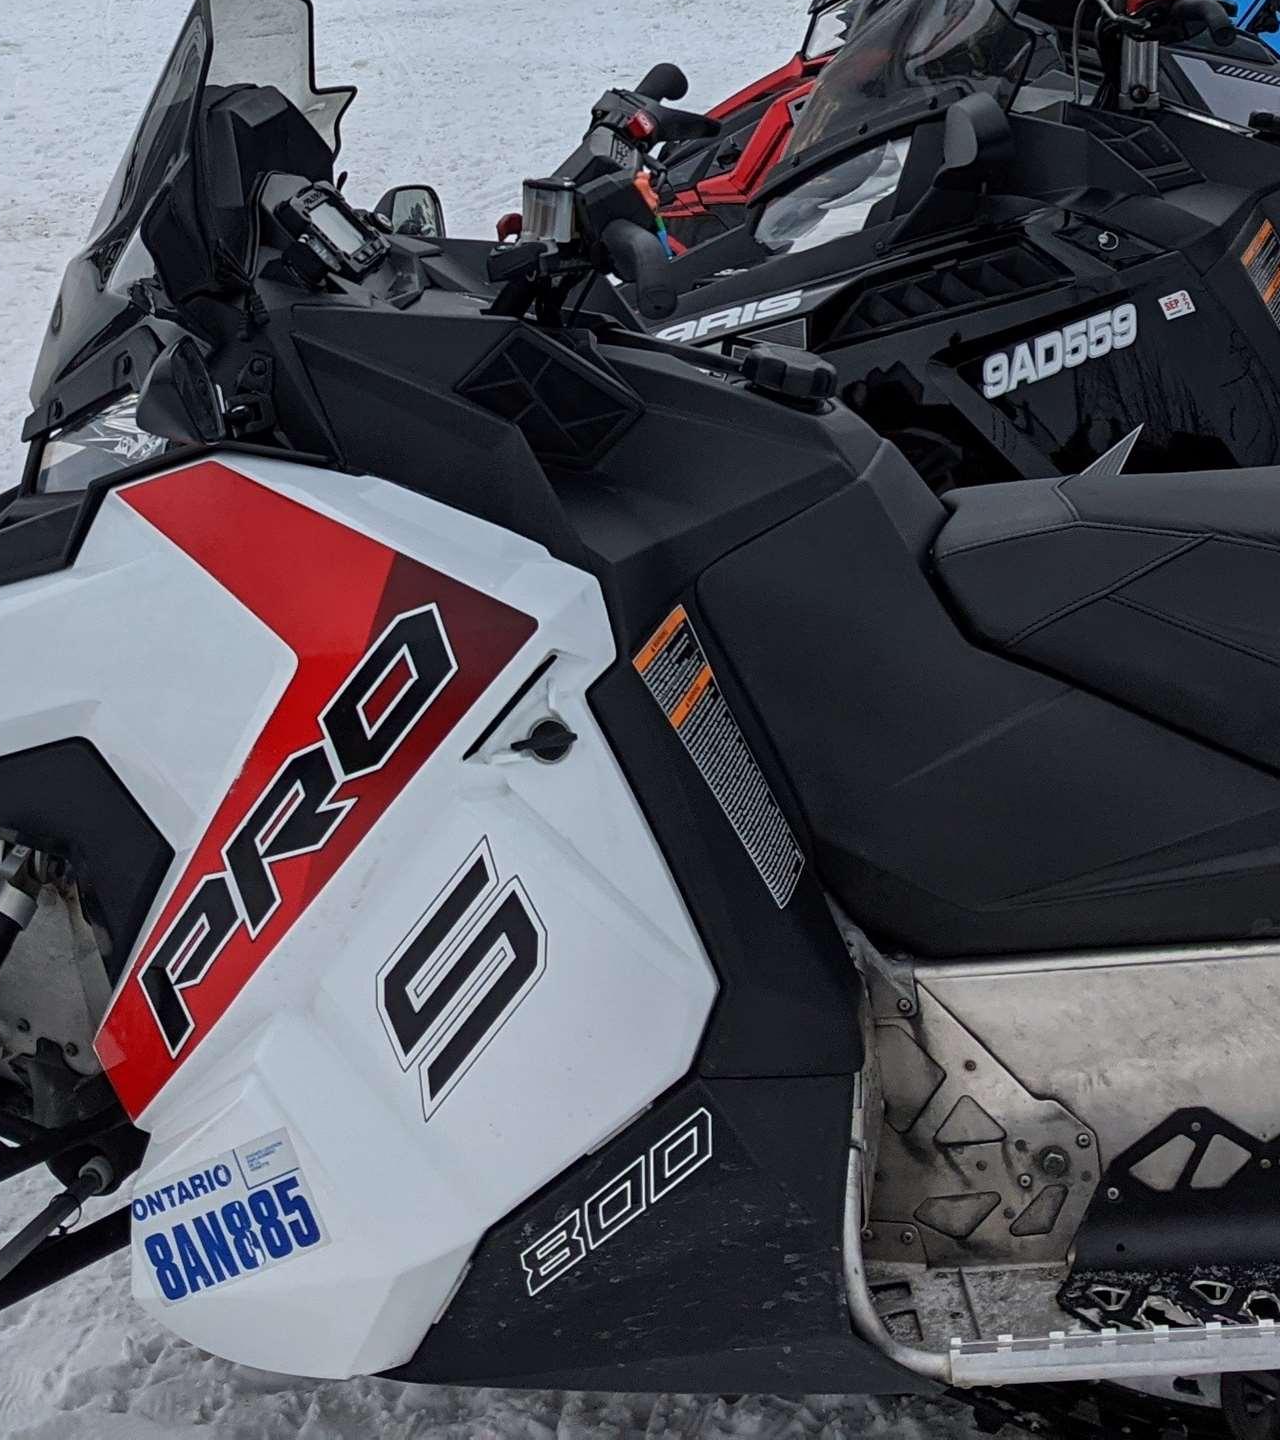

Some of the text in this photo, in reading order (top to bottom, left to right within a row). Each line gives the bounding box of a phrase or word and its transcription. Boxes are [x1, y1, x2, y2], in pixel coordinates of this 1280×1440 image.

[655, 289, 804, 343] ARIS
[982, 302, 1138, 400] 9AD559
[137, 602, 459, 1059] PRO
[132, 1163, 233, 1221] ONTARIO
[144, 1176, 321, 1301] 8AN885
[520, 1107, 713, 1297] 800
